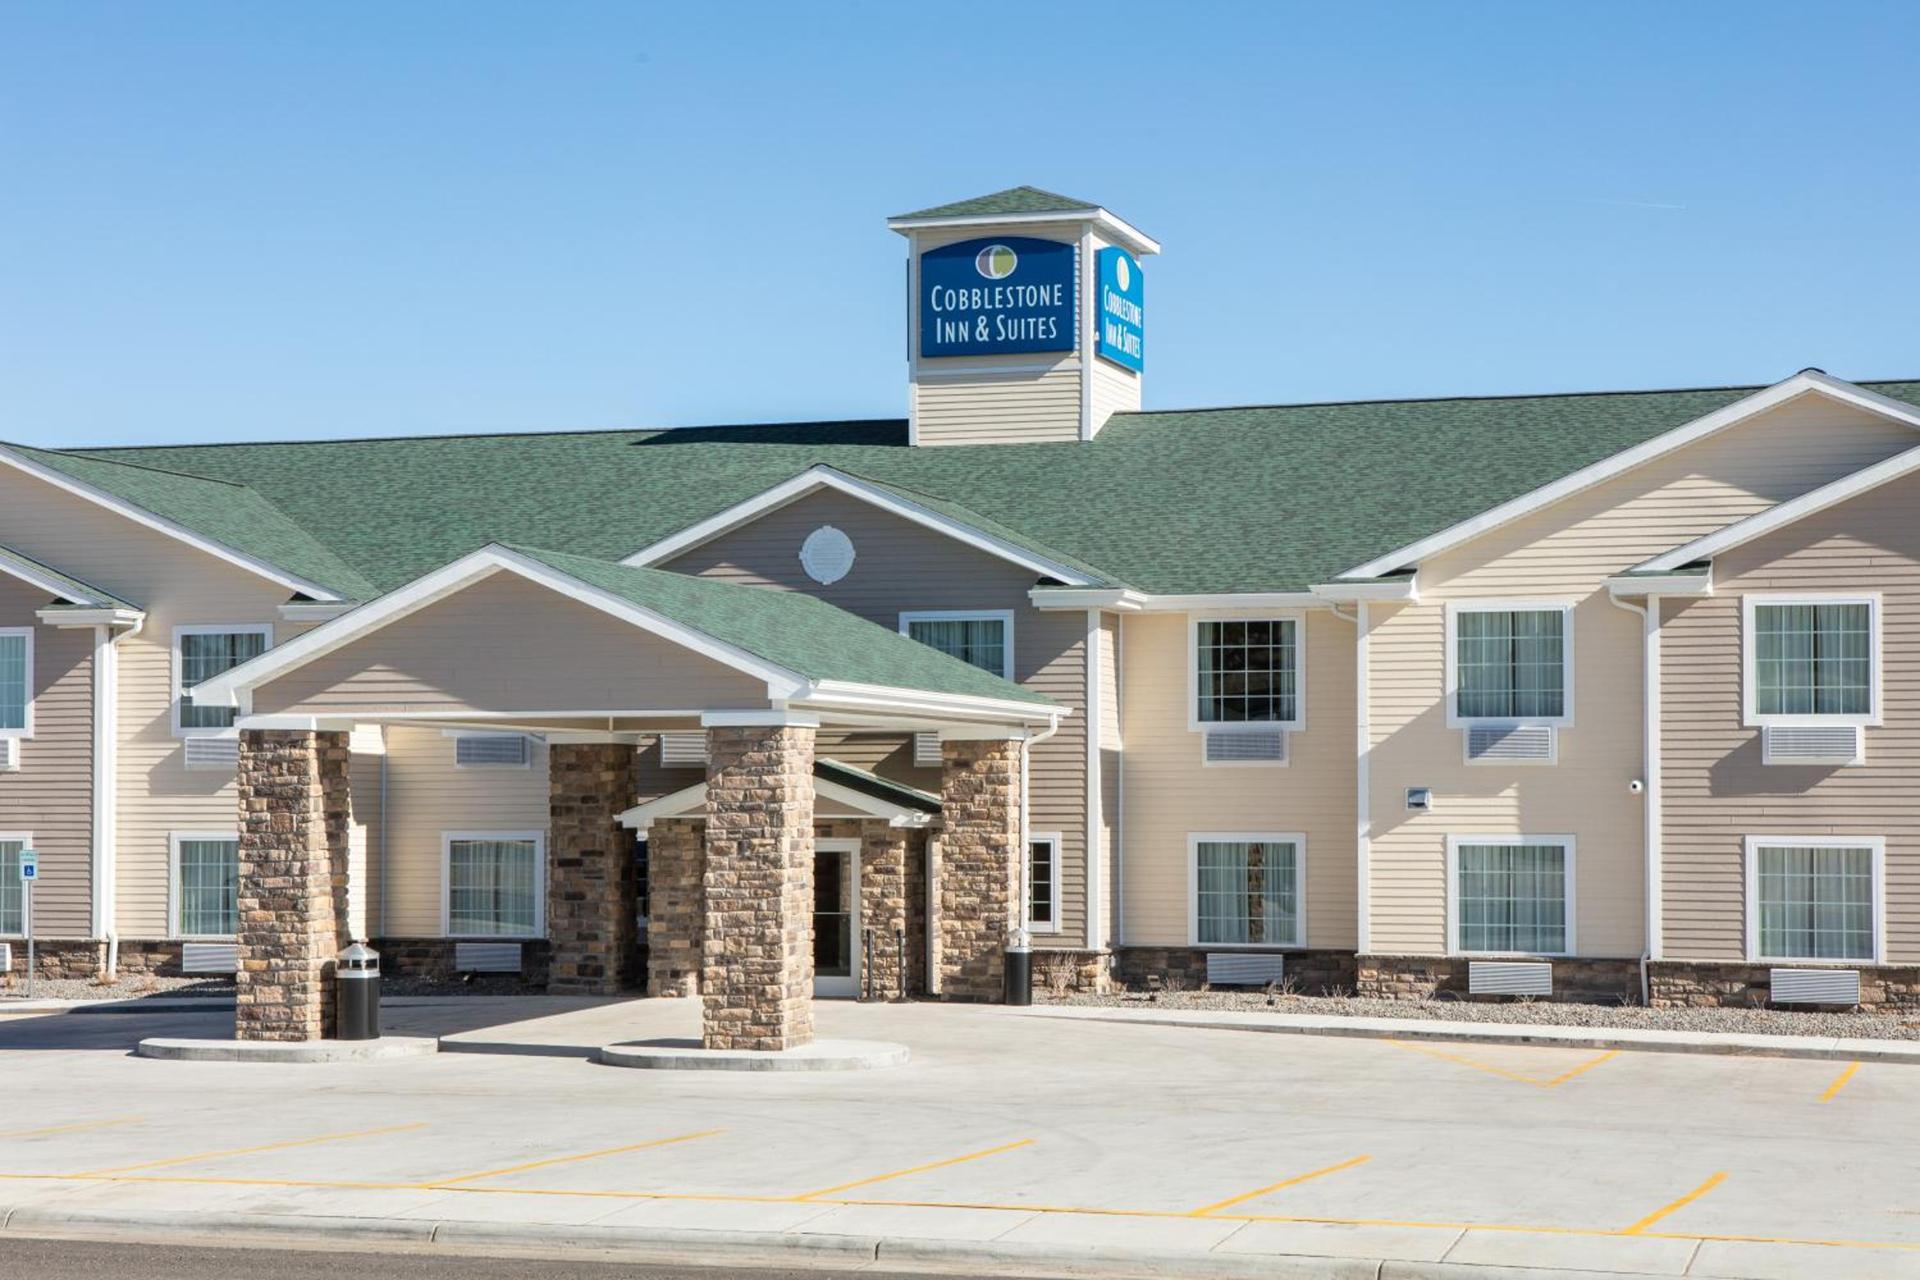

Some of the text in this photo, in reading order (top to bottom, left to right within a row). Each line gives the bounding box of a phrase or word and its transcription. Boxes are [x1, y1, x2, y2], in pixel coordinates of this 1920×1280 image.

[931, 284, 1062, 312] COBBLESTONE
[936, 314, 1057, 344] INN & SUITES
